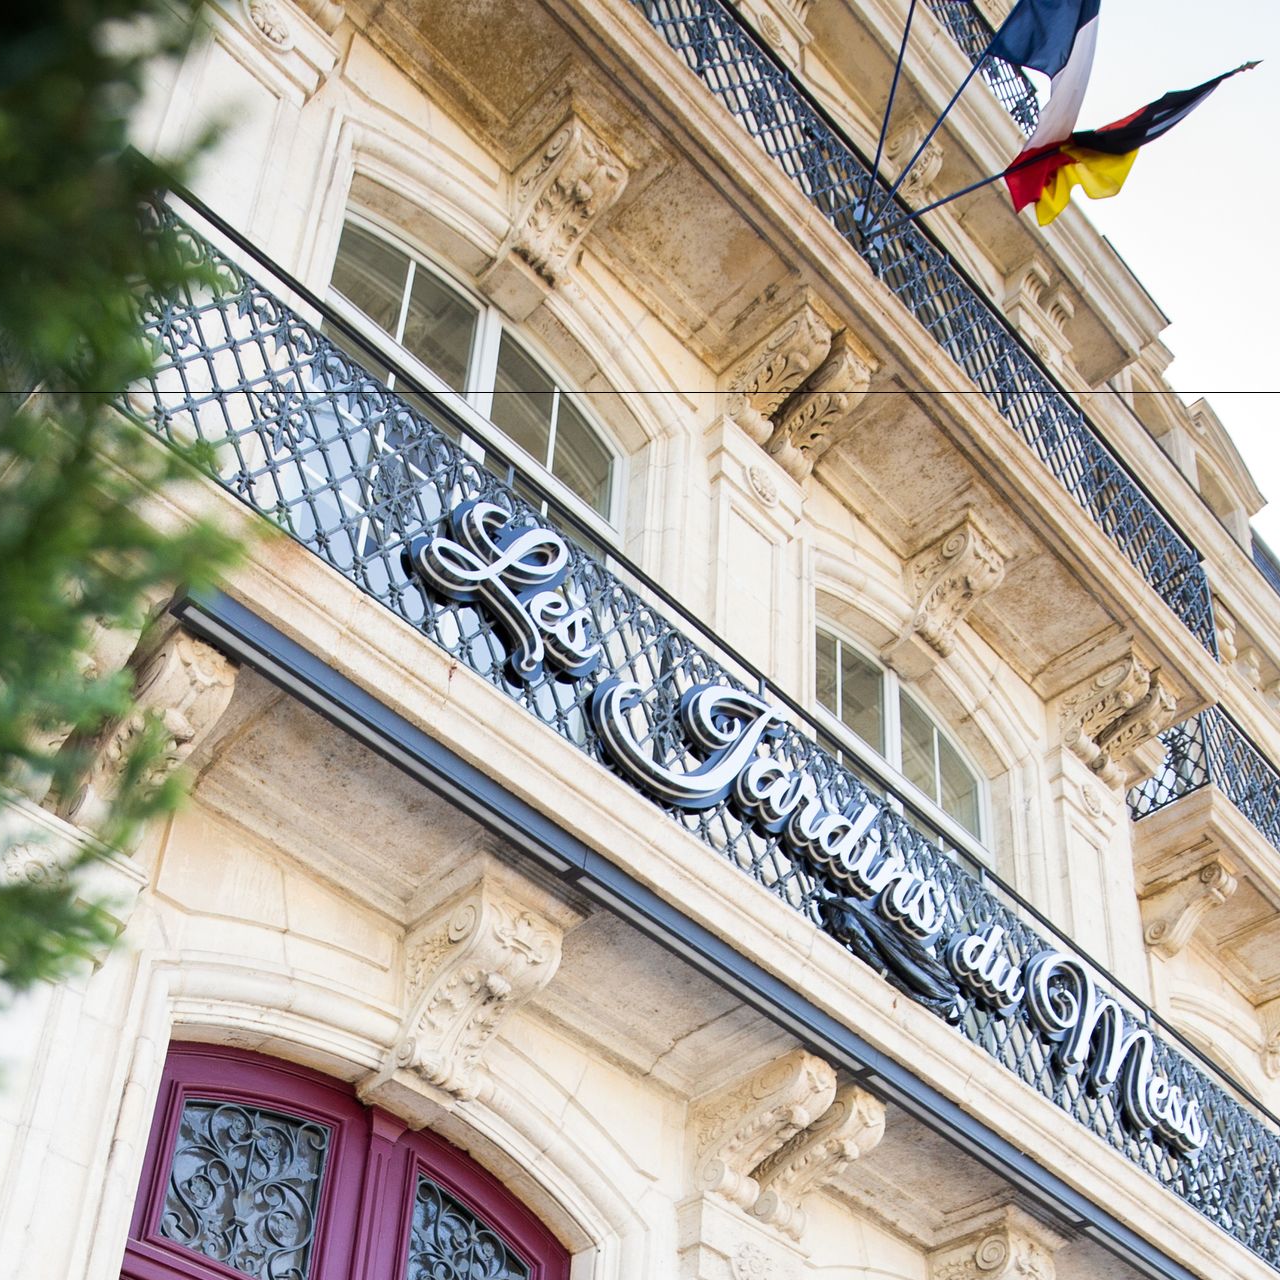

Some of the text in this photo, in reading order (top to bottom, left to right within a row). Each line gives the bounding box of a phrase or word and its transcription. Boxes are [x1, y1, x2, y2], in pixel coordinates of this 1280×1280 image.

[414, 500, 1209, 1151] Les Jardins du Mess
